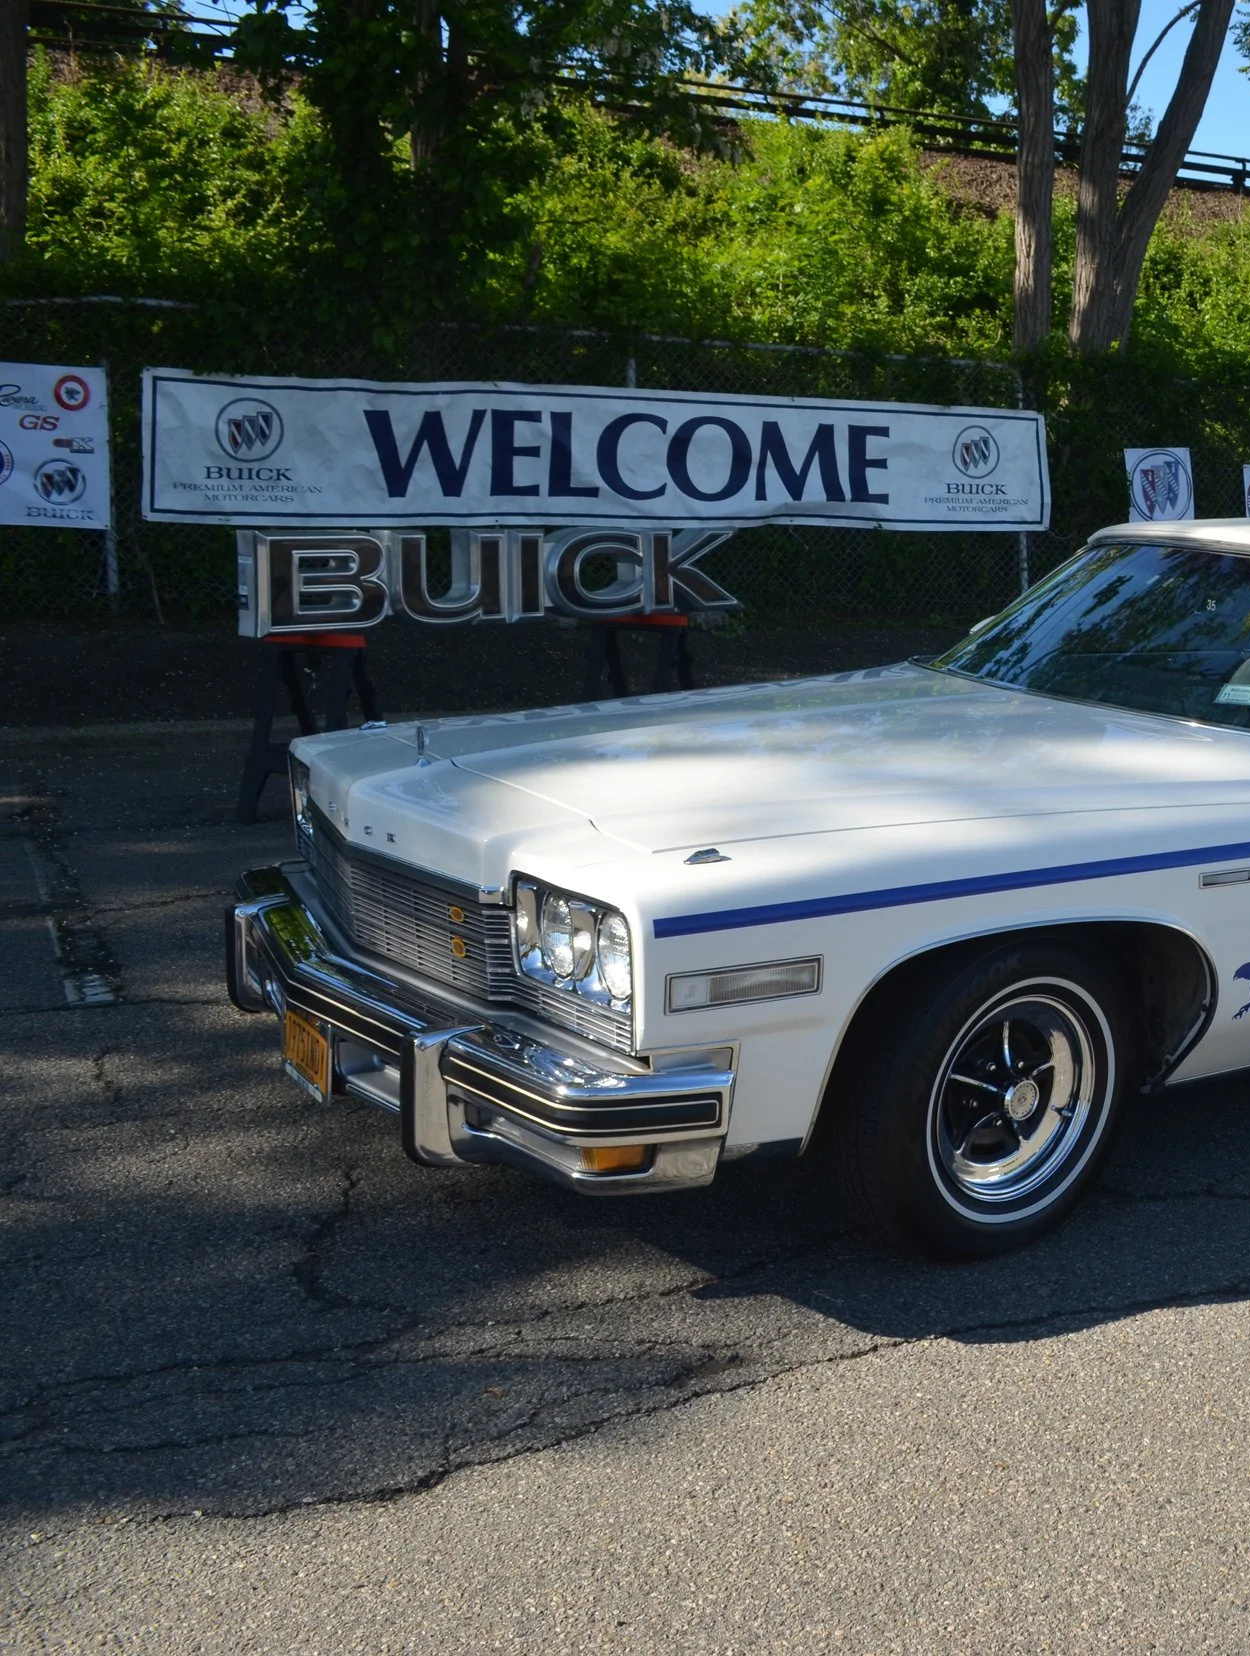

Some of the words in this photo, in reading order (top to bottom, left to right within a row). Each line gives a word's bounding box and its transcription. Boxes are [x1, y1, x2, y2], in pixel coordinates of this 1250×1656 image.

[19, 414, 60, 431] GS
[363, 408, 890, 505] WELCOME
[204, 466, 293, 482] BUICK
[172, 482, 243, 492] PREMIUM
[249, 484, 323, 494] AMERICAN
[945, 483, 1008, 496] BUICK
[204, 494, 294, 503] MOTORCARS
[924, 496, 973, 504] PREMIUM
[976, 498, 1029, 506] AMERICAN
[25, 506, 95, 521] BUICK
[258, 527, 744, 635] BUICK
